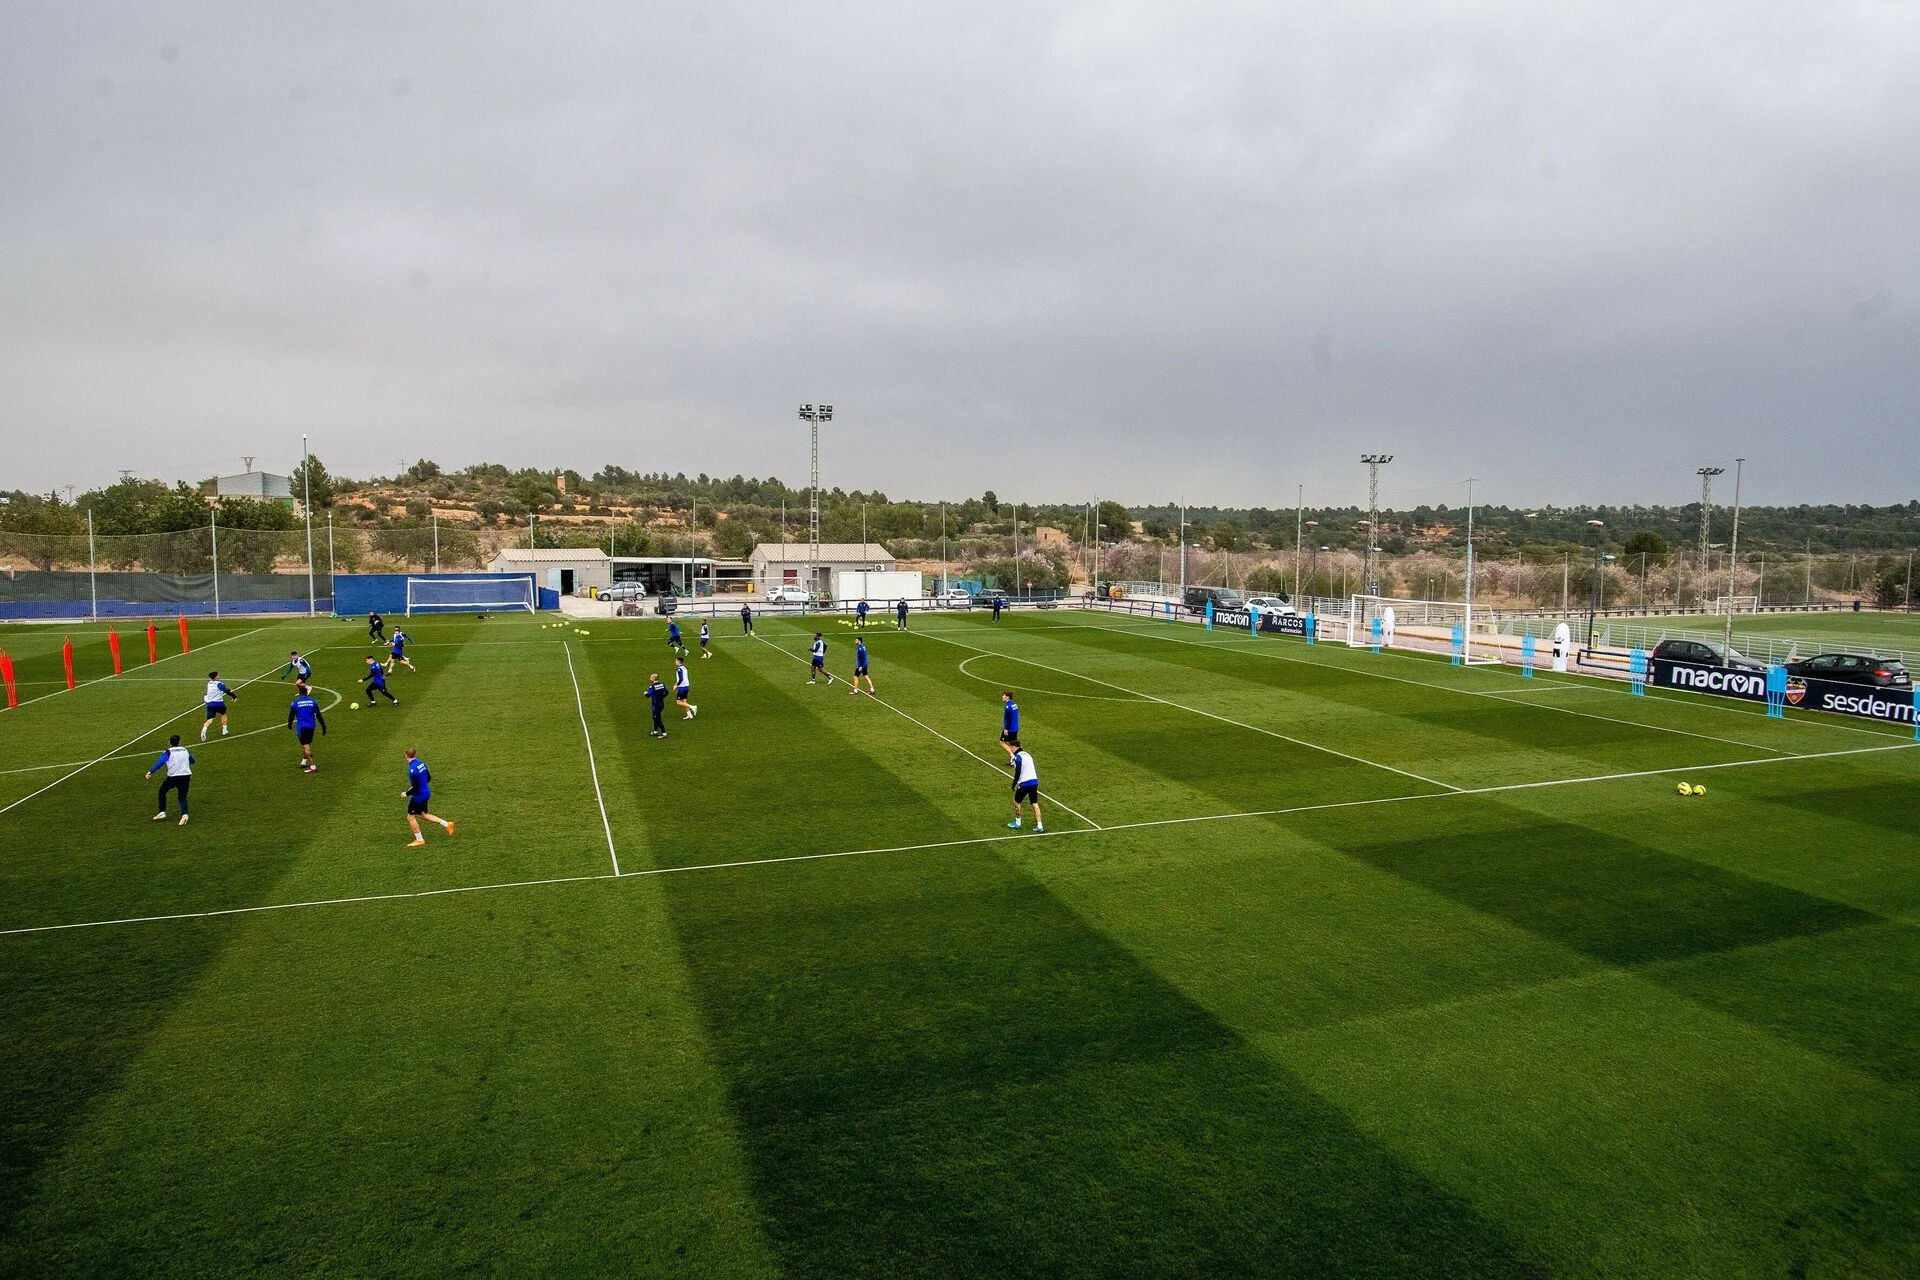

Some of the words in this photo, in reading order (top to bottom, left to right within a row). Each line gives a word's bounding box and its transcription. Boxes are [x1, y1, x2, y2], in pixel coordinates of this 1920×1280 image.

[1216, 612, 1249, 626] macron
[1672, 666, 1765, 696] macron
[1822, 693, 1920, 722] sesderm
